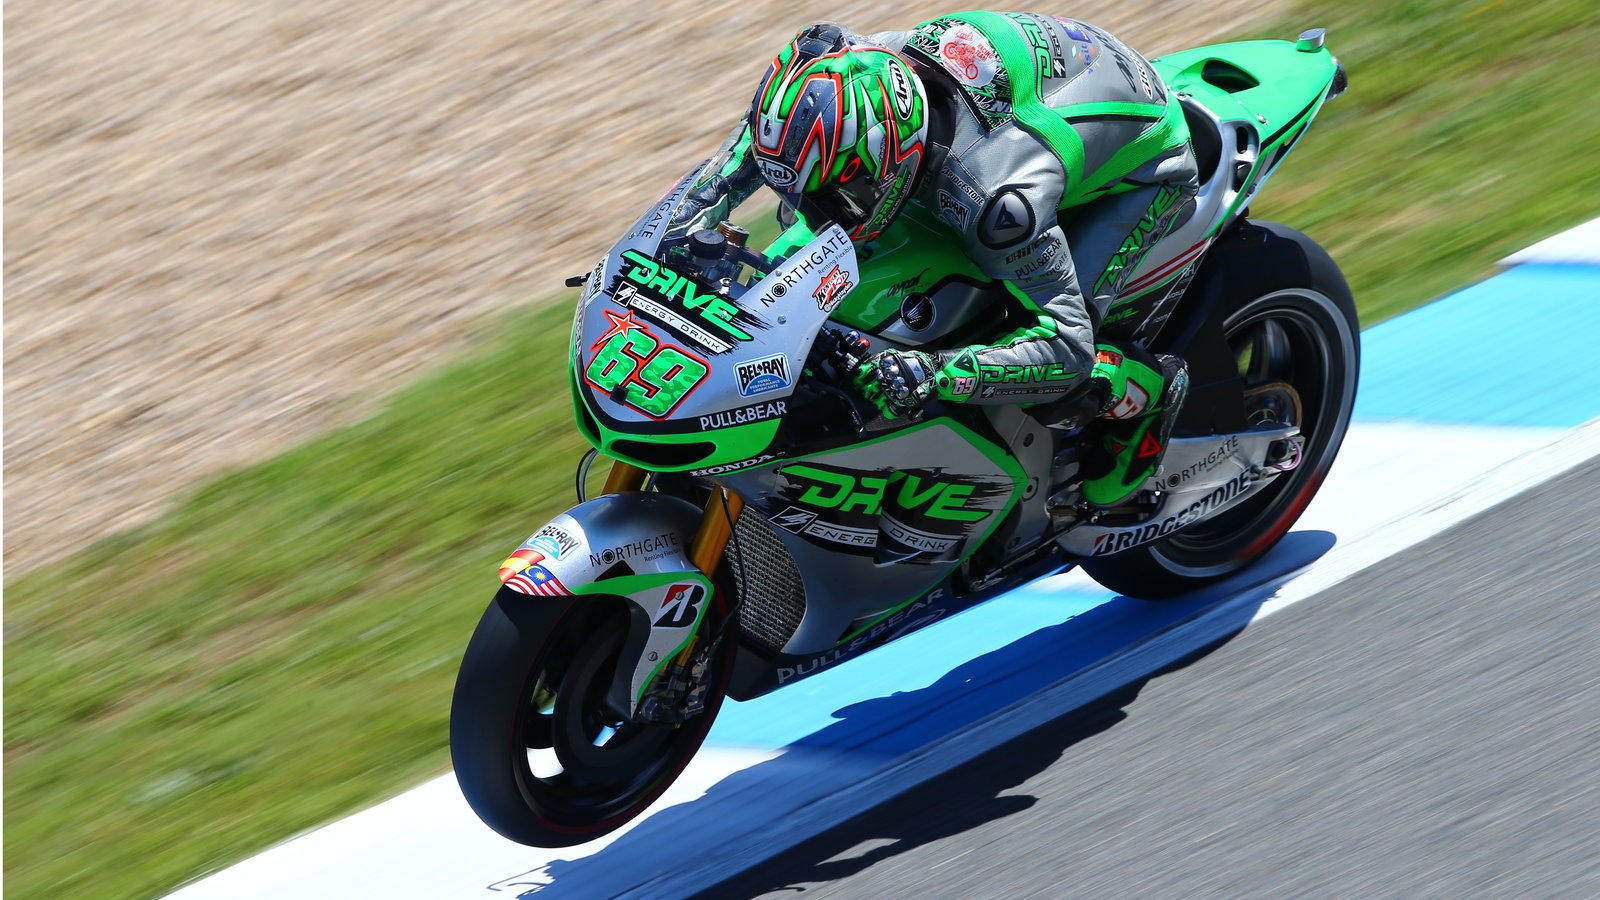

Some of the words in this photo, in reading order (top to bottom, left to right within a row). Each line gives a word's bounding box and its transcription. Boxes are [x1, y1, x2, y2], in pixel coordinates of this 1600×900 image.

[895, 65, 909, 114] Arai
[762, 161, 788, 179] Arai
[942, 167, 985, 207] BRIDGESTONE
[817, 260, 837, 274] Renting
[836, 245, 853, 261] Flexible
[1015, 238, 1062, 280] PULL&BEAR
[1093, 183, 1181, 296] DRIVE
[760, 231, 848, 308] NORTHGATE
[621, 250, 754, 340] DRIVE
[631, 297, 675, 322] ENERGY
[680, 322, 721, 351] DRINK
[586, 327, 709, 419] 69
[952, 376, 977, 395] 69
[981, 363, 1080, 383] DRIVE
[700, 400, 787, 430] PULL&BEAR
[690, 454, 775, 477] HONDA
[1155, 435, 1239, 492] NORTHGATE
[1094, 468, 1251, 553] BRIDGESTONE
[590, 532, 678, 567] NORTHGATE
[644, 553, 664, 562] Renting
[889, 527, 949, 550] DRINK
